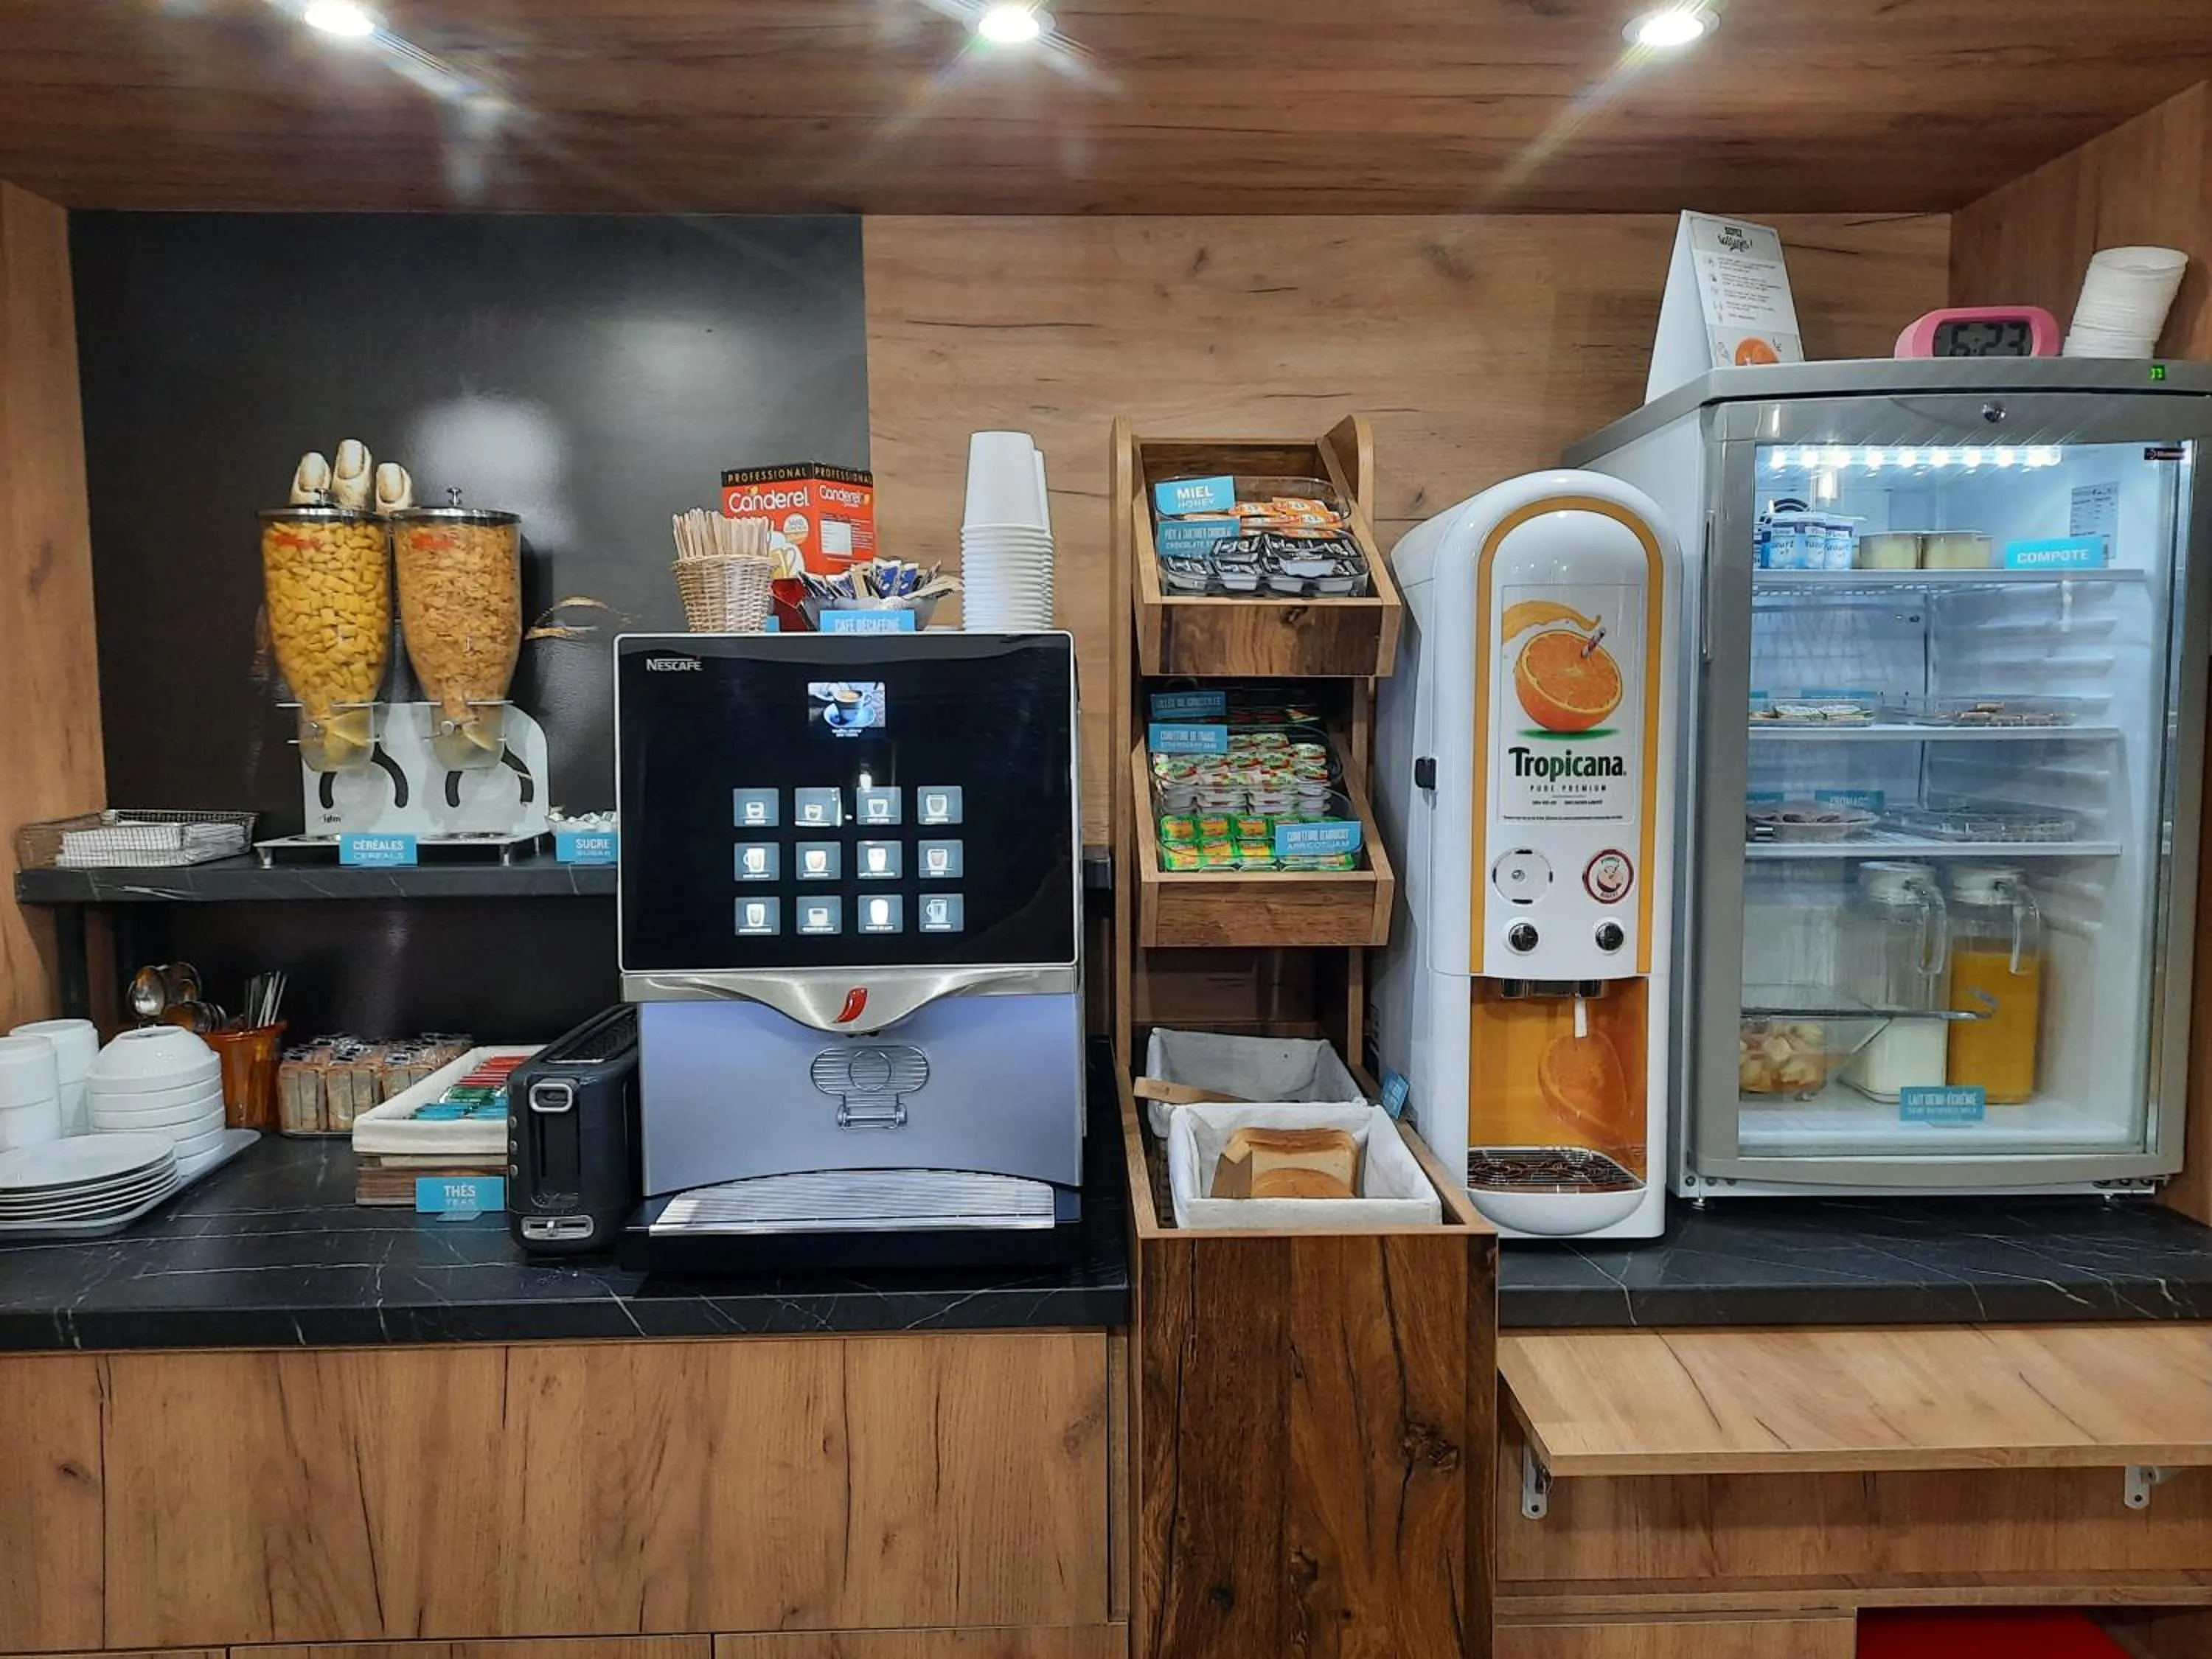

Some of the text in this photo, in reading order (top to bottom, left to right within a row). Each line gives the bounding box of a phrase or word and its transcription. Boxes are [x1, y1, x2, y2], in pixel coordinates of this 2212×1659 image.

[728, 467, 807, 483] PROFESSIONAL
[728, 486, 810, 512] Canderel
[818, 484, 861, 504] Canderel
[1177, 485, 1214, 499] MIEL
[1178, 498, 1215, 509] HONEY
[2017, 549, 2090, 564] COMPOTE
[1508, 746, 1624, 782] Tropicana
[353, 838, 405, 850] CÉRÉALES
[576, 838, 611, 849] SUCRE
[443, 1182, 476, 1197] THÉS
